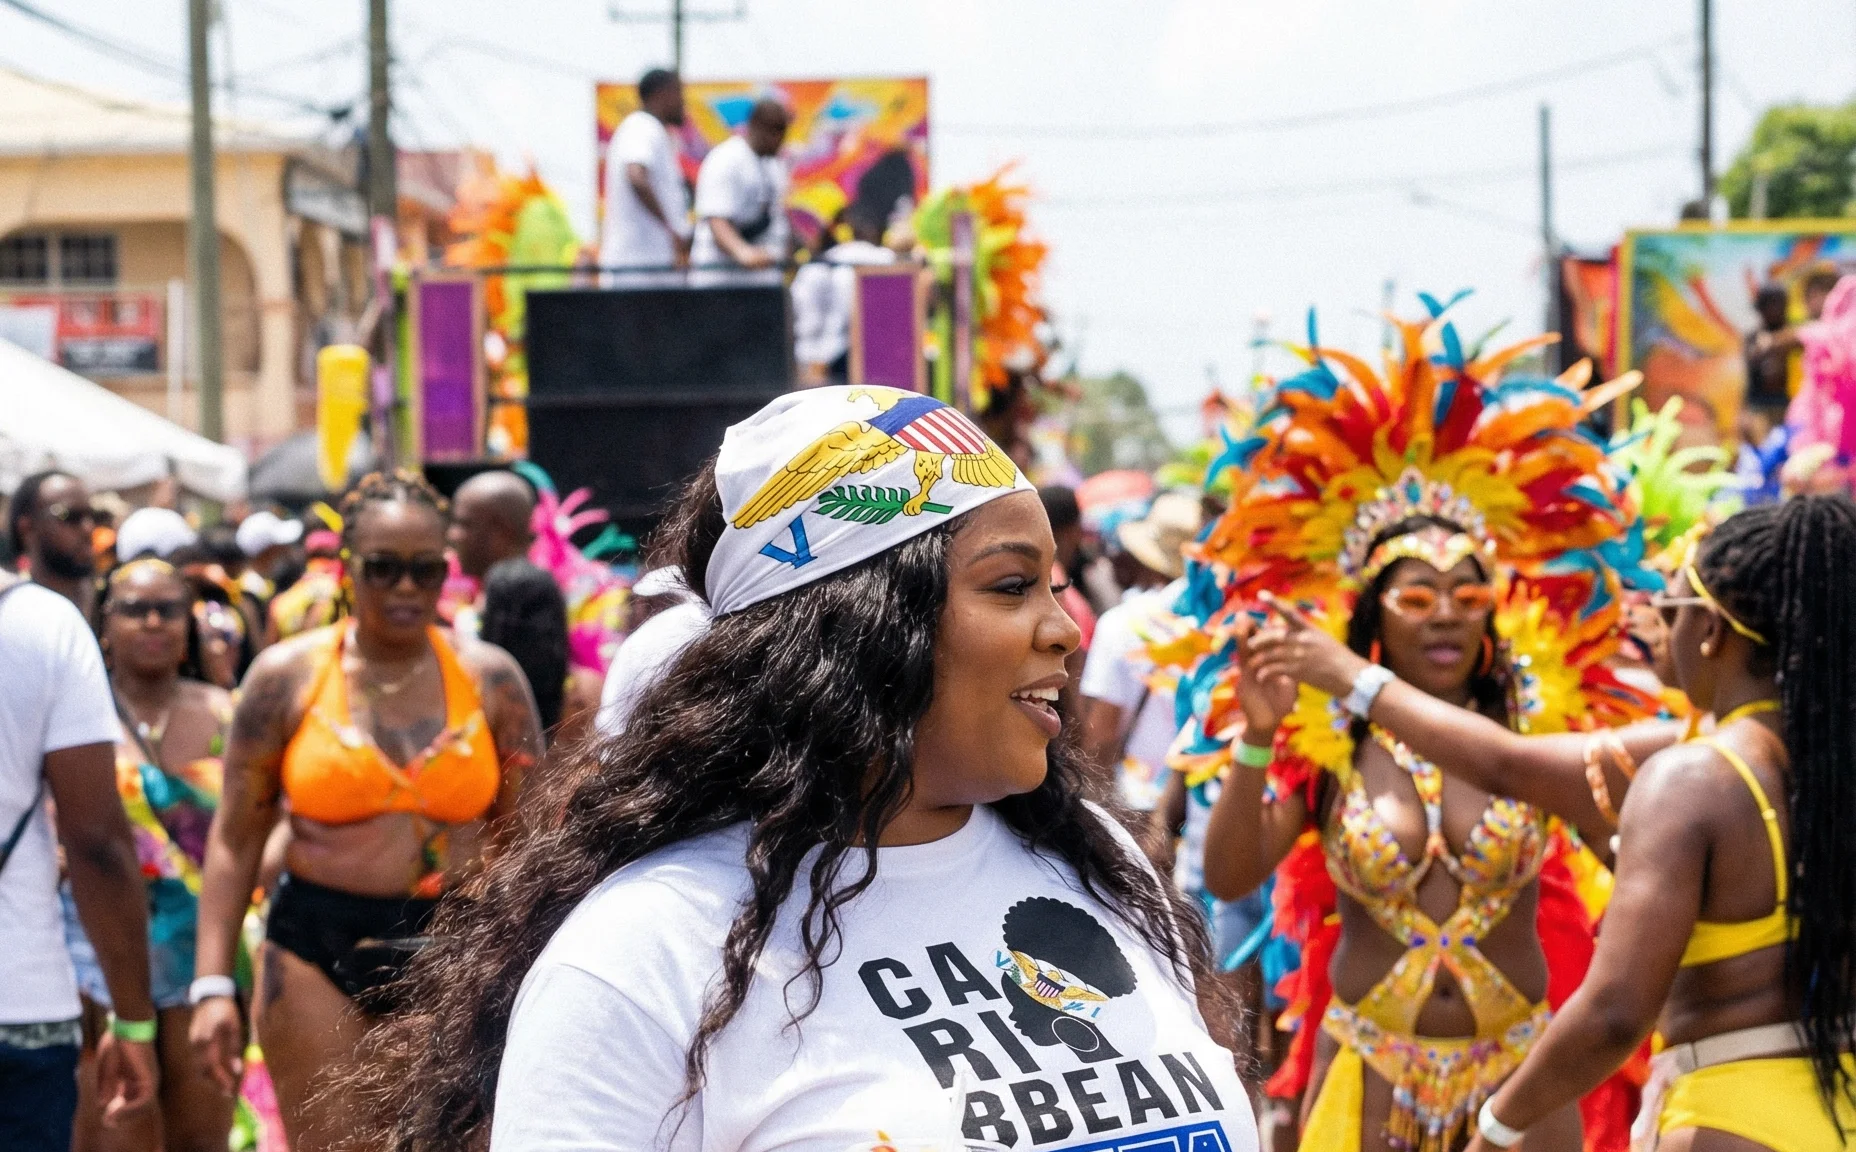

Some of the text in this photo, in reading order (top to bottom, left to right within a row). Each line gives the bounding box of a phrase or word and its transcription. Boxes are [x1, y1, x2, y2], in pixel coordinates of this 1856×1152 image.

[758, 515, 818, 569] V
[858, 941, 1003, 1019] CA
[903, 1010, 1042, 1090] RI
[961, 1052, 1224, 1149] BBEAN
